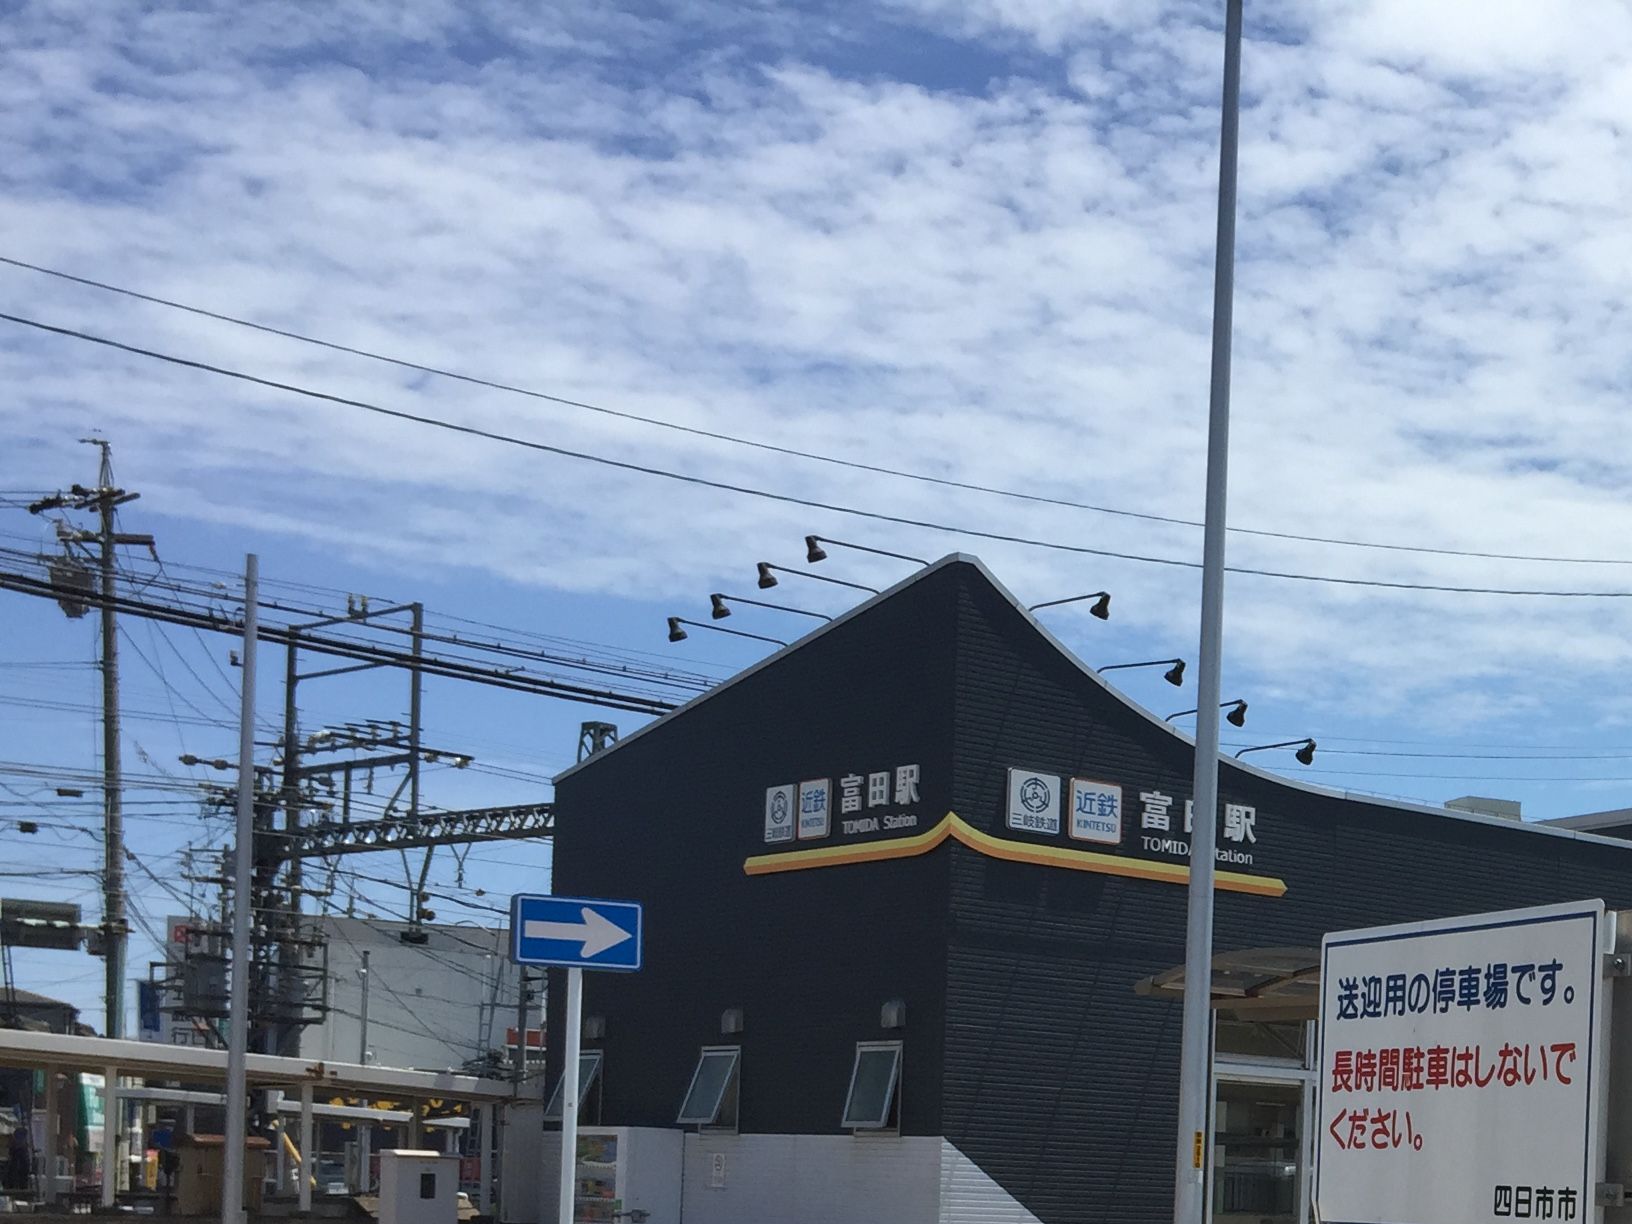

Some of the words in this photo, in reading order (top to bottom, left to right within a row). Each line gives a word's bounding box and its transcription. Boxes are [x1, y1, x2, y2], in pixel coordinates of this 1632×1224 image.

[801, 788, 827, 814] 近鉄
[840, 764, 920, 814] 富田駅
[1076, 790, 1118, 818] 近鉄
[841, 817, 880, 834] TOMIDA
[884, 813, 918, 829] Station
[1011, 812, 1058, 832] 三岐鉄道
[1077, 819, 1117, 833] KINTETSU
[1215, 845, 1254, 866] tation
[1336, 958, 1576, 1020] 送迎用の停車場です。
[1331, 1041, 1577, 1093] 長時間駐車はしないで
[1329, 1108, 1424, 1152] ください。
[1494, 1185, 1578, 1221] 四日市市
